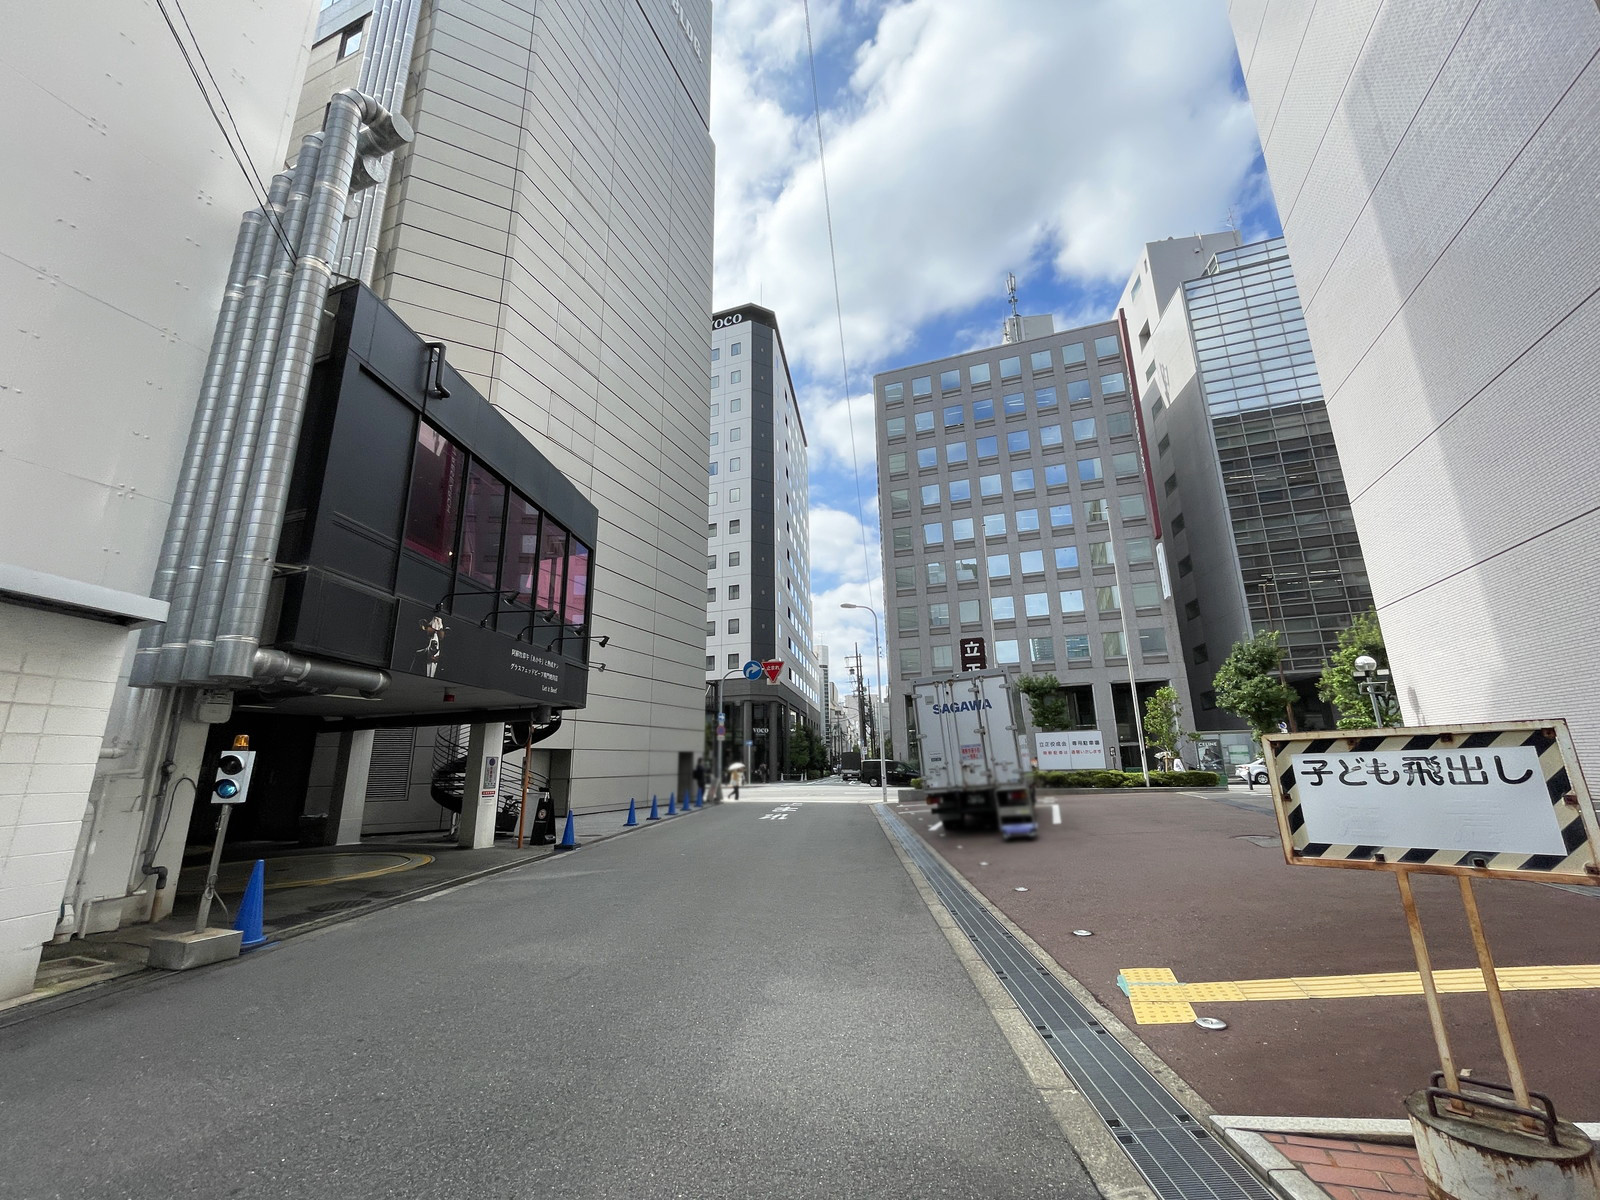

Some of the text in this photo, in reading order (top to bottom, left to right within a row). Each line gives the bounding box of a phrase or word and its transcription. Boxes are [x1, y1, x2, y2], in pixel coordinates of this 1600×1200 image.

[711, 313, 743, 329] oco
[932, 698, 993, 715] SAGAWA
[1300, 754, 1534, 787] 子ども飛出し
